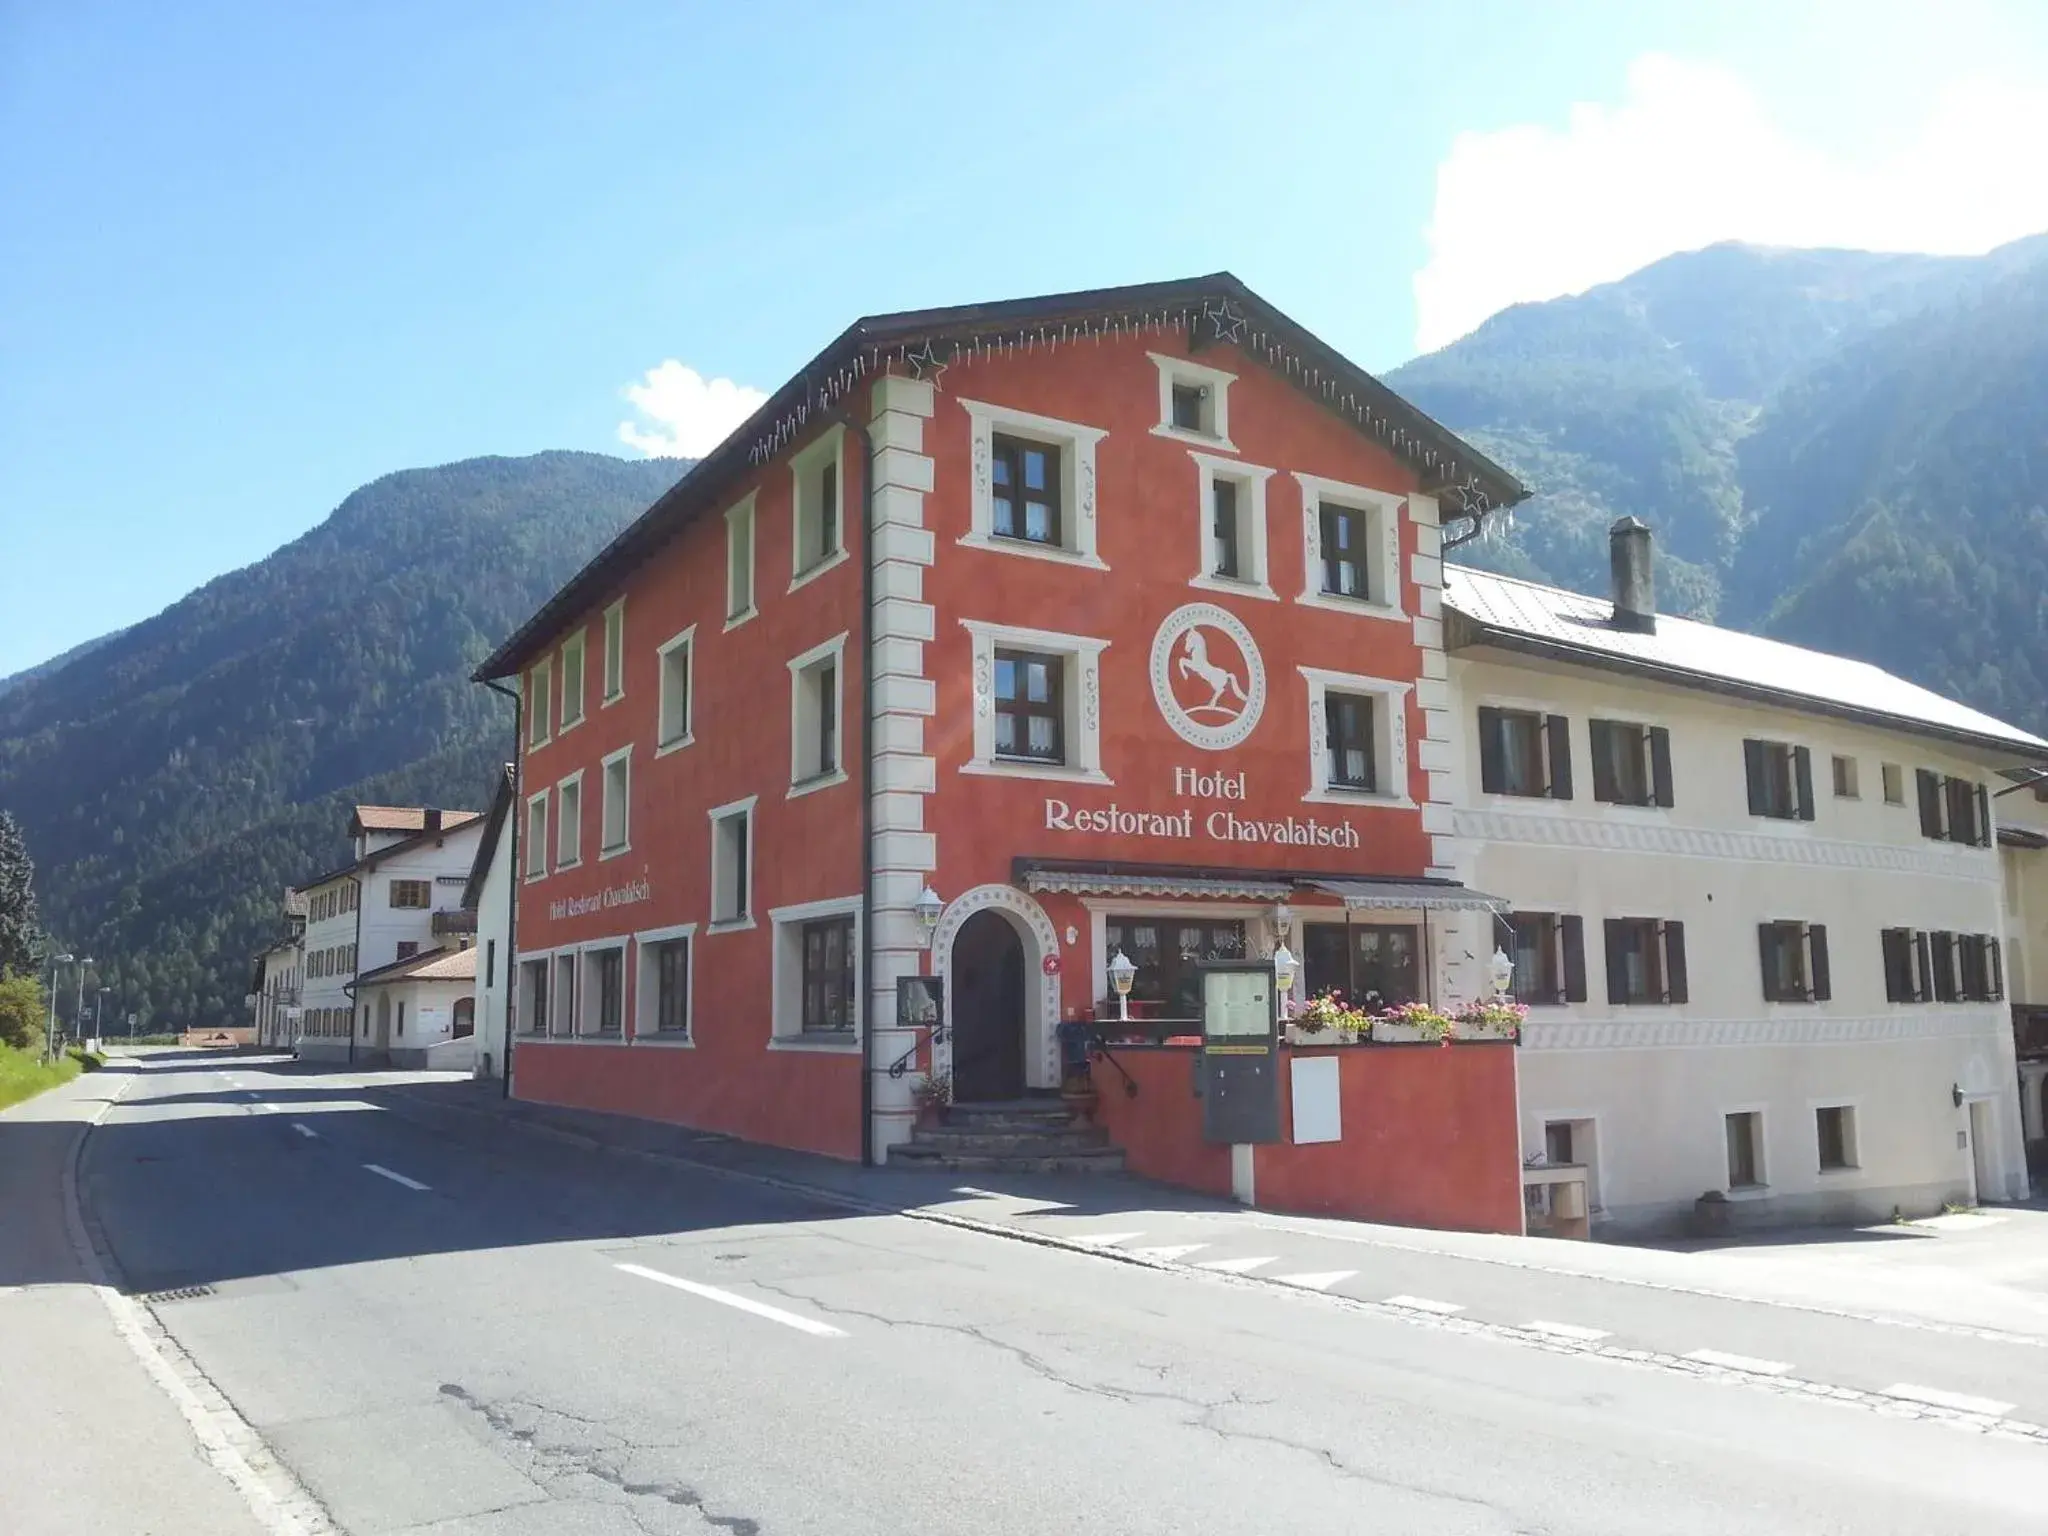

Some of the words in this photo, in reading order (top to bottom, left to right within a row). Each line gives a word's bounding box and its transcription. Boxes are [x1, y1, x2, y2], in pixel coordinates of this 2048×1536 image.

[1175, 767, 1246, 799] Hotel
[1045, 799, 1192, 837] Restorant
[1206, 812, 1359, 848] Chavalatsch
